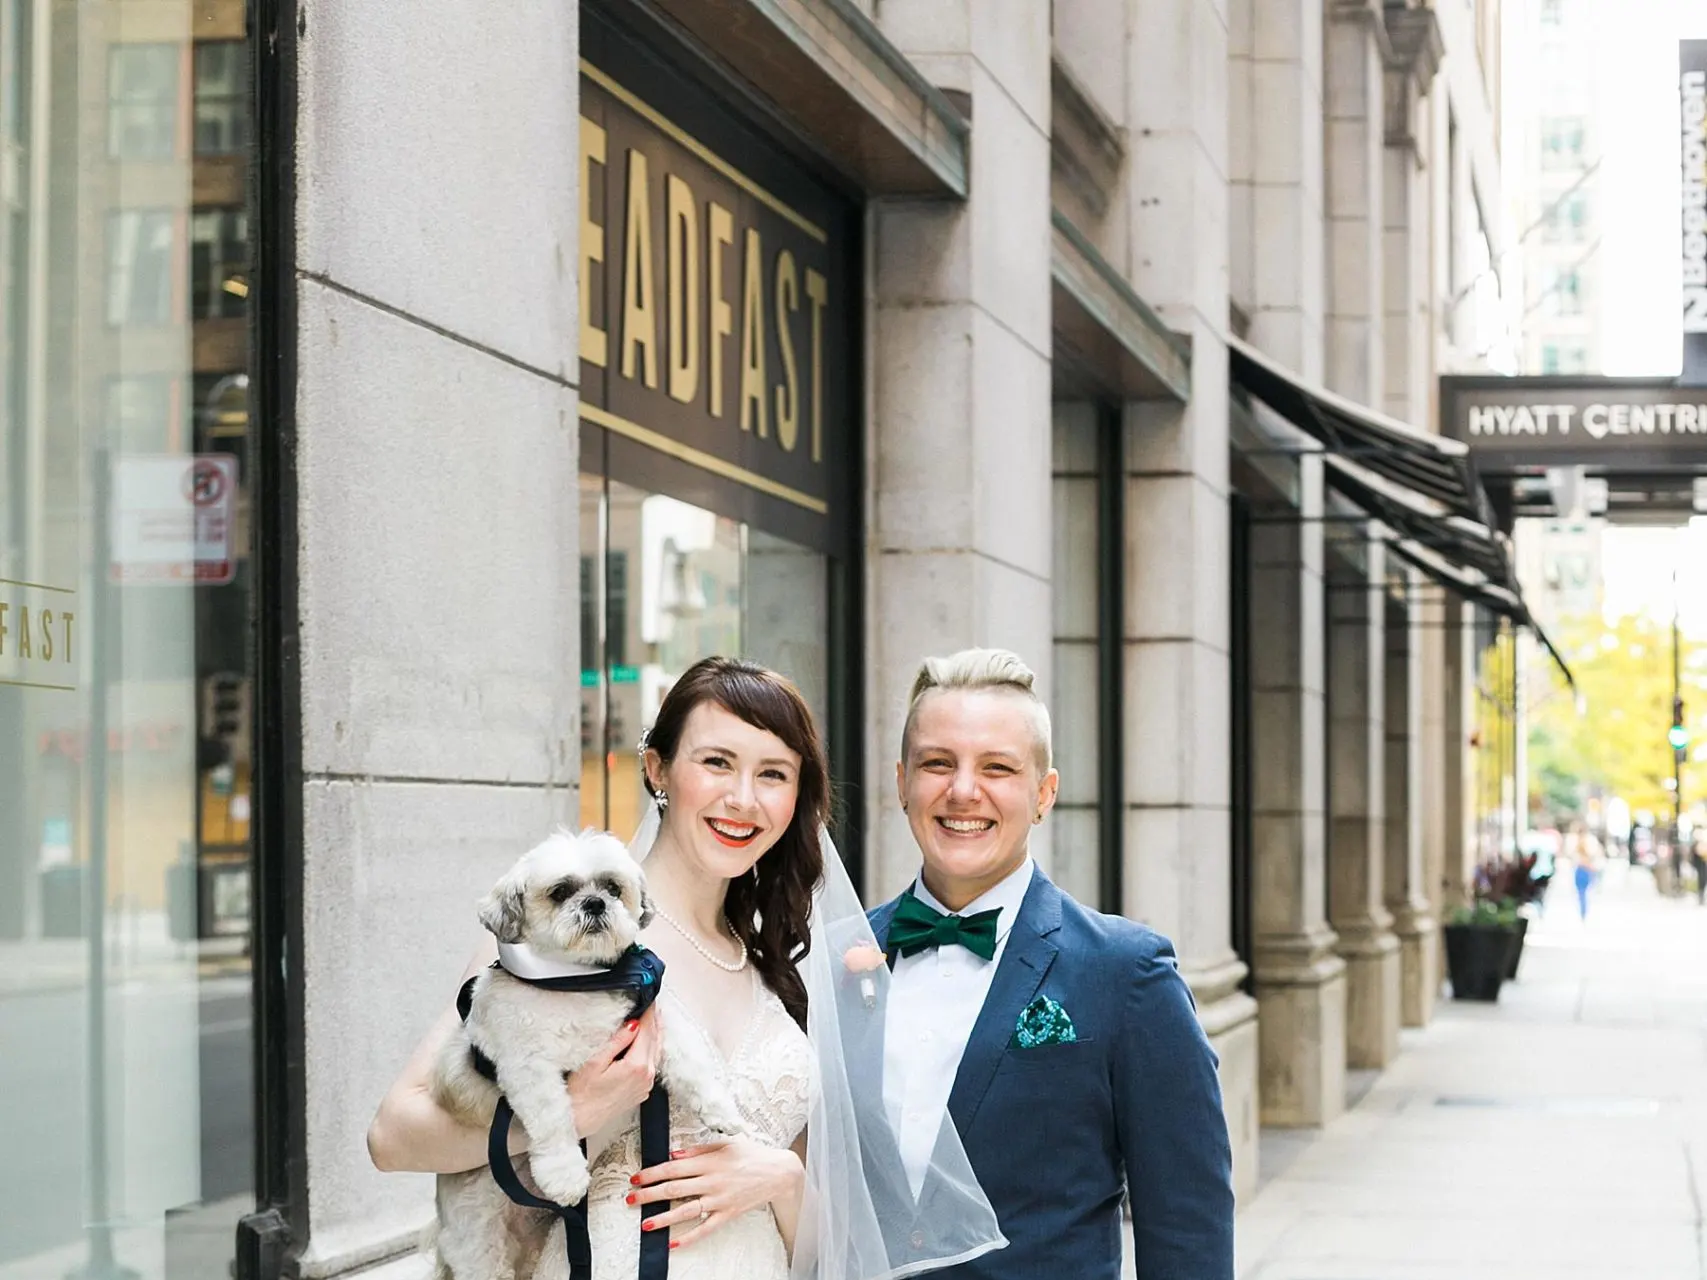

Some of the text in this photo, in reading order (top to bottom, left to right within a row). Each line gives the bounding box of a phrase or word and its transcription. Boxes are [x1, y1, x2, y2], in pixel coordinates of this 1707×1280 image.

[579, 114, 827, 463] EADFAST
[1469, 403, 1707, 439] HYATT CENTRI
[0, 602, 74, 664] FAST
